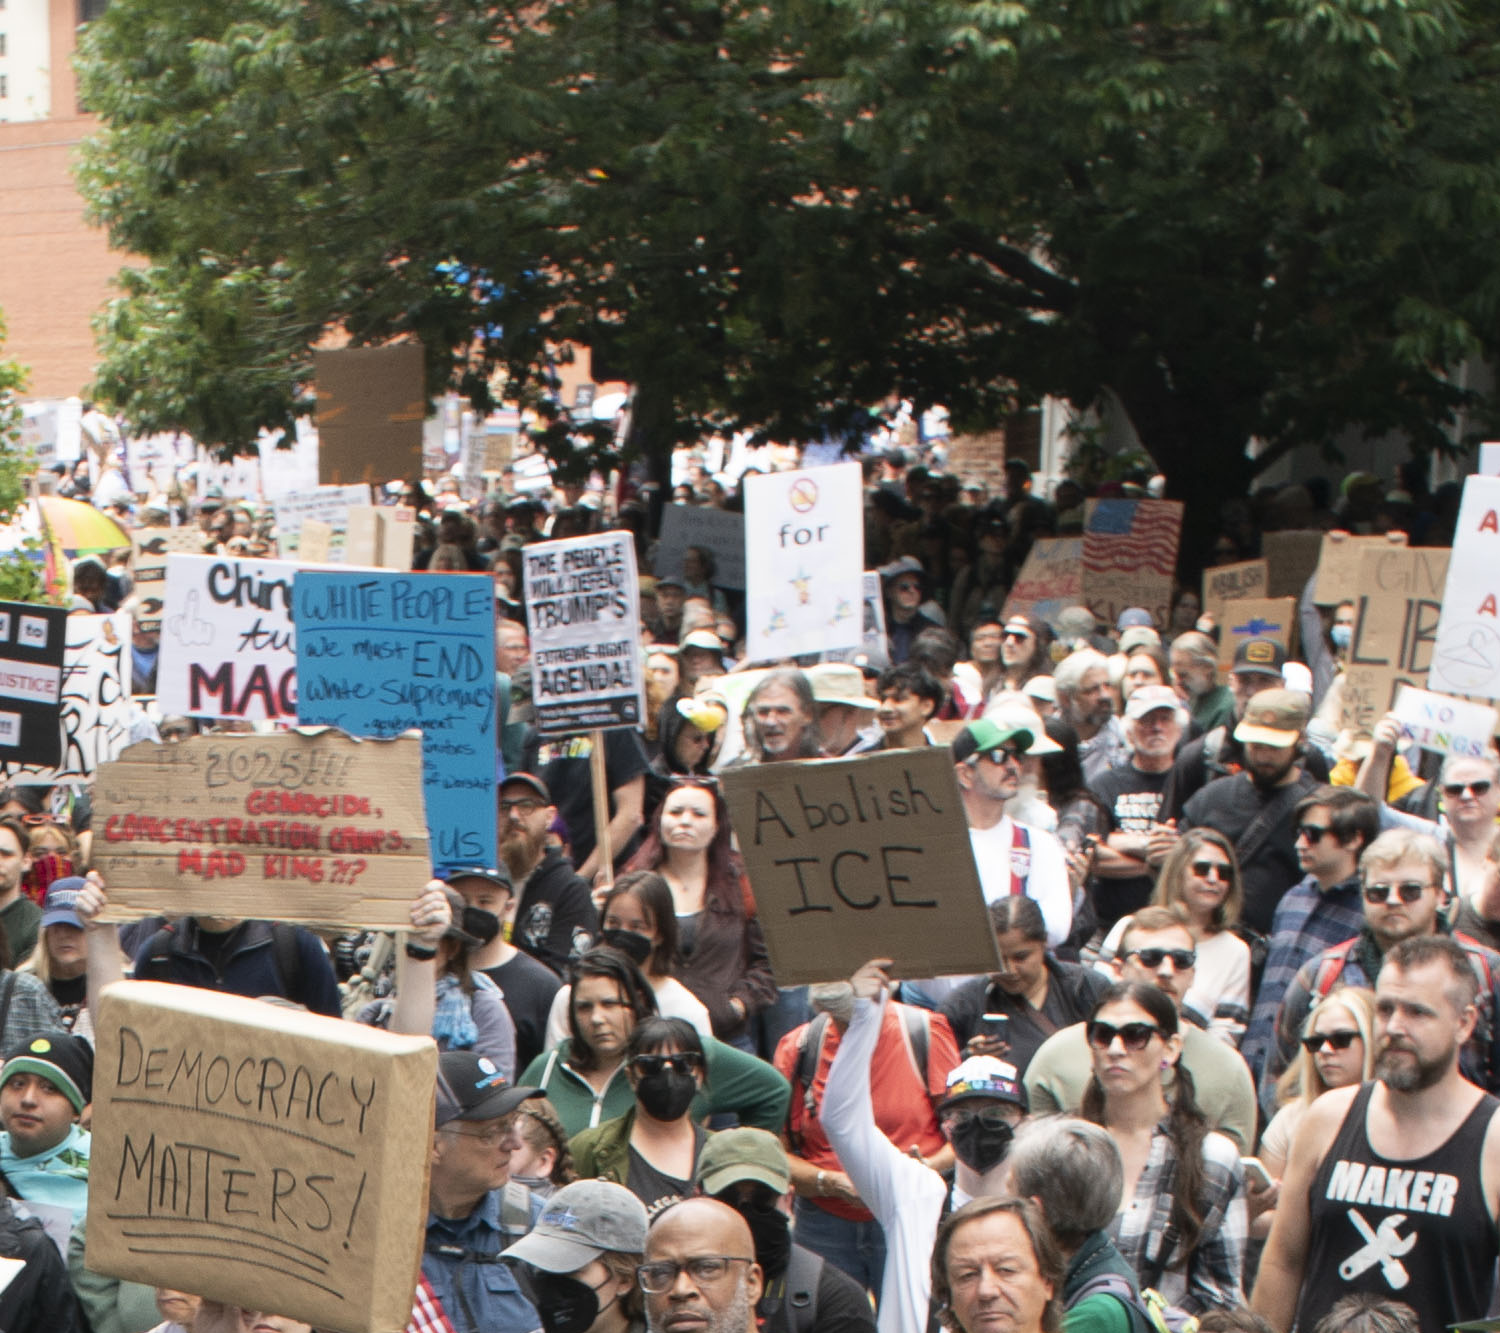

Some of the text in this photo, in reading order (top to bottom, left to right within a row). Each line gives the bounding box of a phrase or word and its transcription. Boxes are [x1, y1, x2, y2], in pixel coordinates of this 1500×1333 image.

[779, 521, 831, 548] for
[302, 580, 492, 624] WHITE PEOPLE:
[1477, 593, 1498, 618] A
[23, 621, 45, 643] to
[413, 640, 484, 682] END
[1424, 703, 1455, 723] NO
[1401, 722, 1483, 757] KINGS
[751, 767, 943, 846] Abolish
[177, 850, 246, 880] MAD
[774, 844, 939, 917] ICE
[117, 1026, 376, 1134] DEMOCRACY
[114, 1132, 367, 1251] MATTERS!
[1326, 1161, 1460, 1217] MAKER
